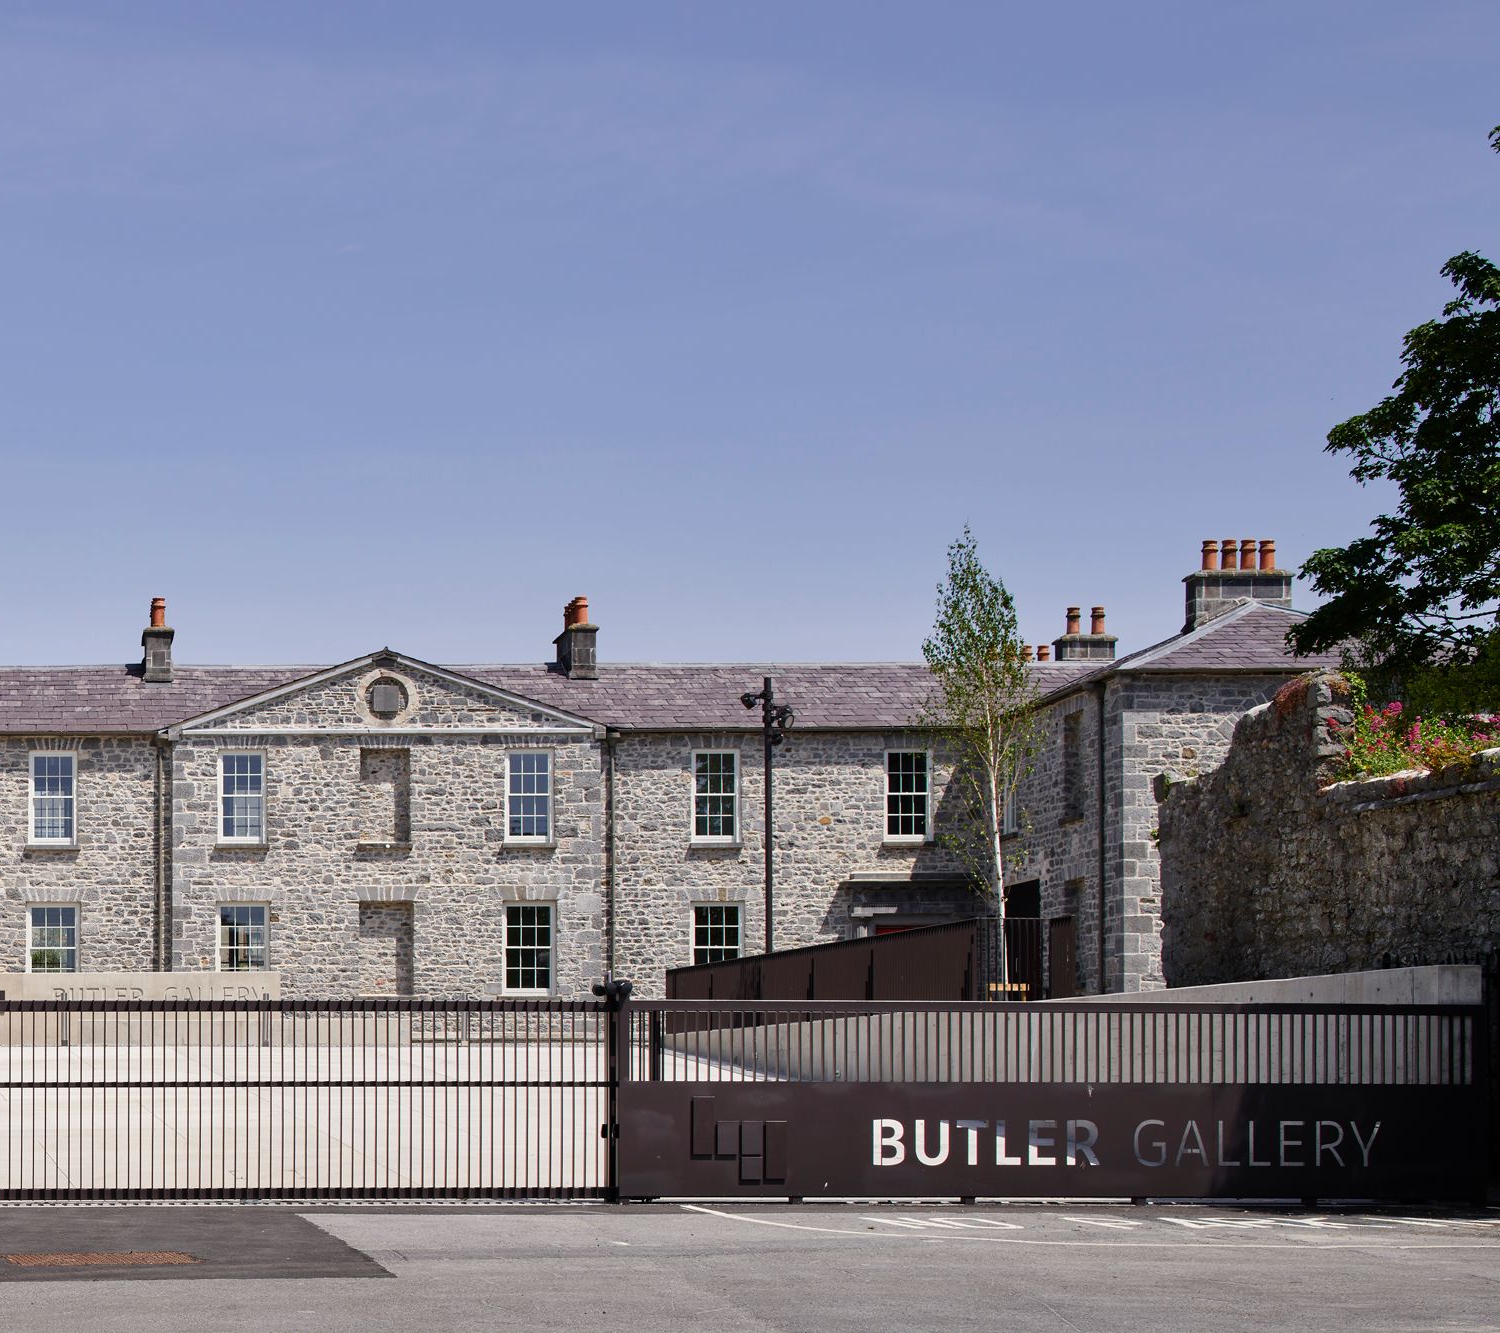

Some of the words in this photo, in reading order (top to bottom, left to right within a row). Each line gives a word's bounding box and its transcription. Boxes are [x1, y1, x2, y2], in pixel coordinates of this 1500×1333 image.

[872, 1118, 1100, 1167] BUTLER
[1133, 1119, 1382, 1167] GALLERY
[858, 1216, 1024, 1230] NO
